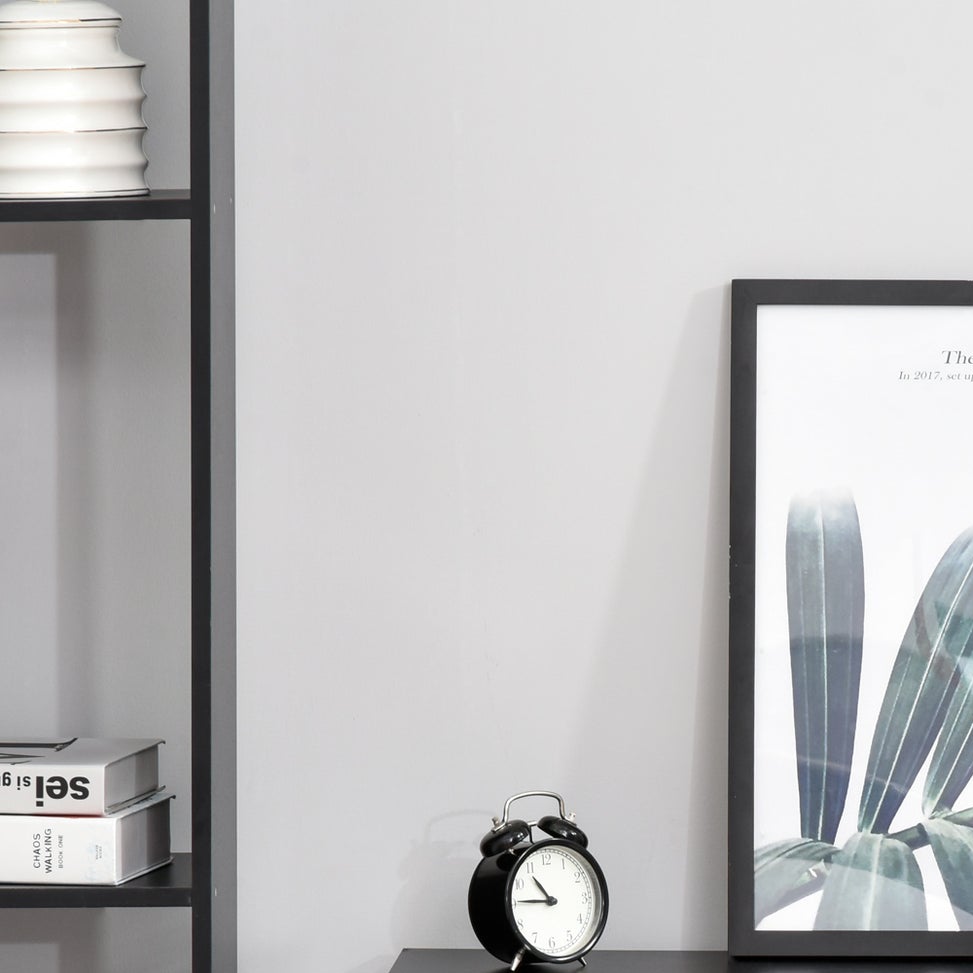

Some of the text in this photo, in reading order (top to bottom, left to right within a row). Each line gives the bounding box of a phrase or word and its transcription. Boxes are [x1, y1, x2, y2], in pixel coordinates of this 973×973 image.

[898, 371, 910, 381] In
[913, 371, 943, 382] 2017,
[946, 372, 961, 381] set
[0, 771, 91, 807] sei si g
[32, 833, 41, 869] CHAOS
[44, 828, 53, 874] WALKING
[541, 854, 552, 866] 12
[560, 858, 566, 870] 1
[526, 862, 535, 874] 11
[573, 872, 581, 884] 2
[515, 879, 524, 890] 10
[576, 913, 583, 925] 4
[532, 932, 538, 944] 7
[566, 930, 573, 942] 5
[548, 937, 556, 949] 6
